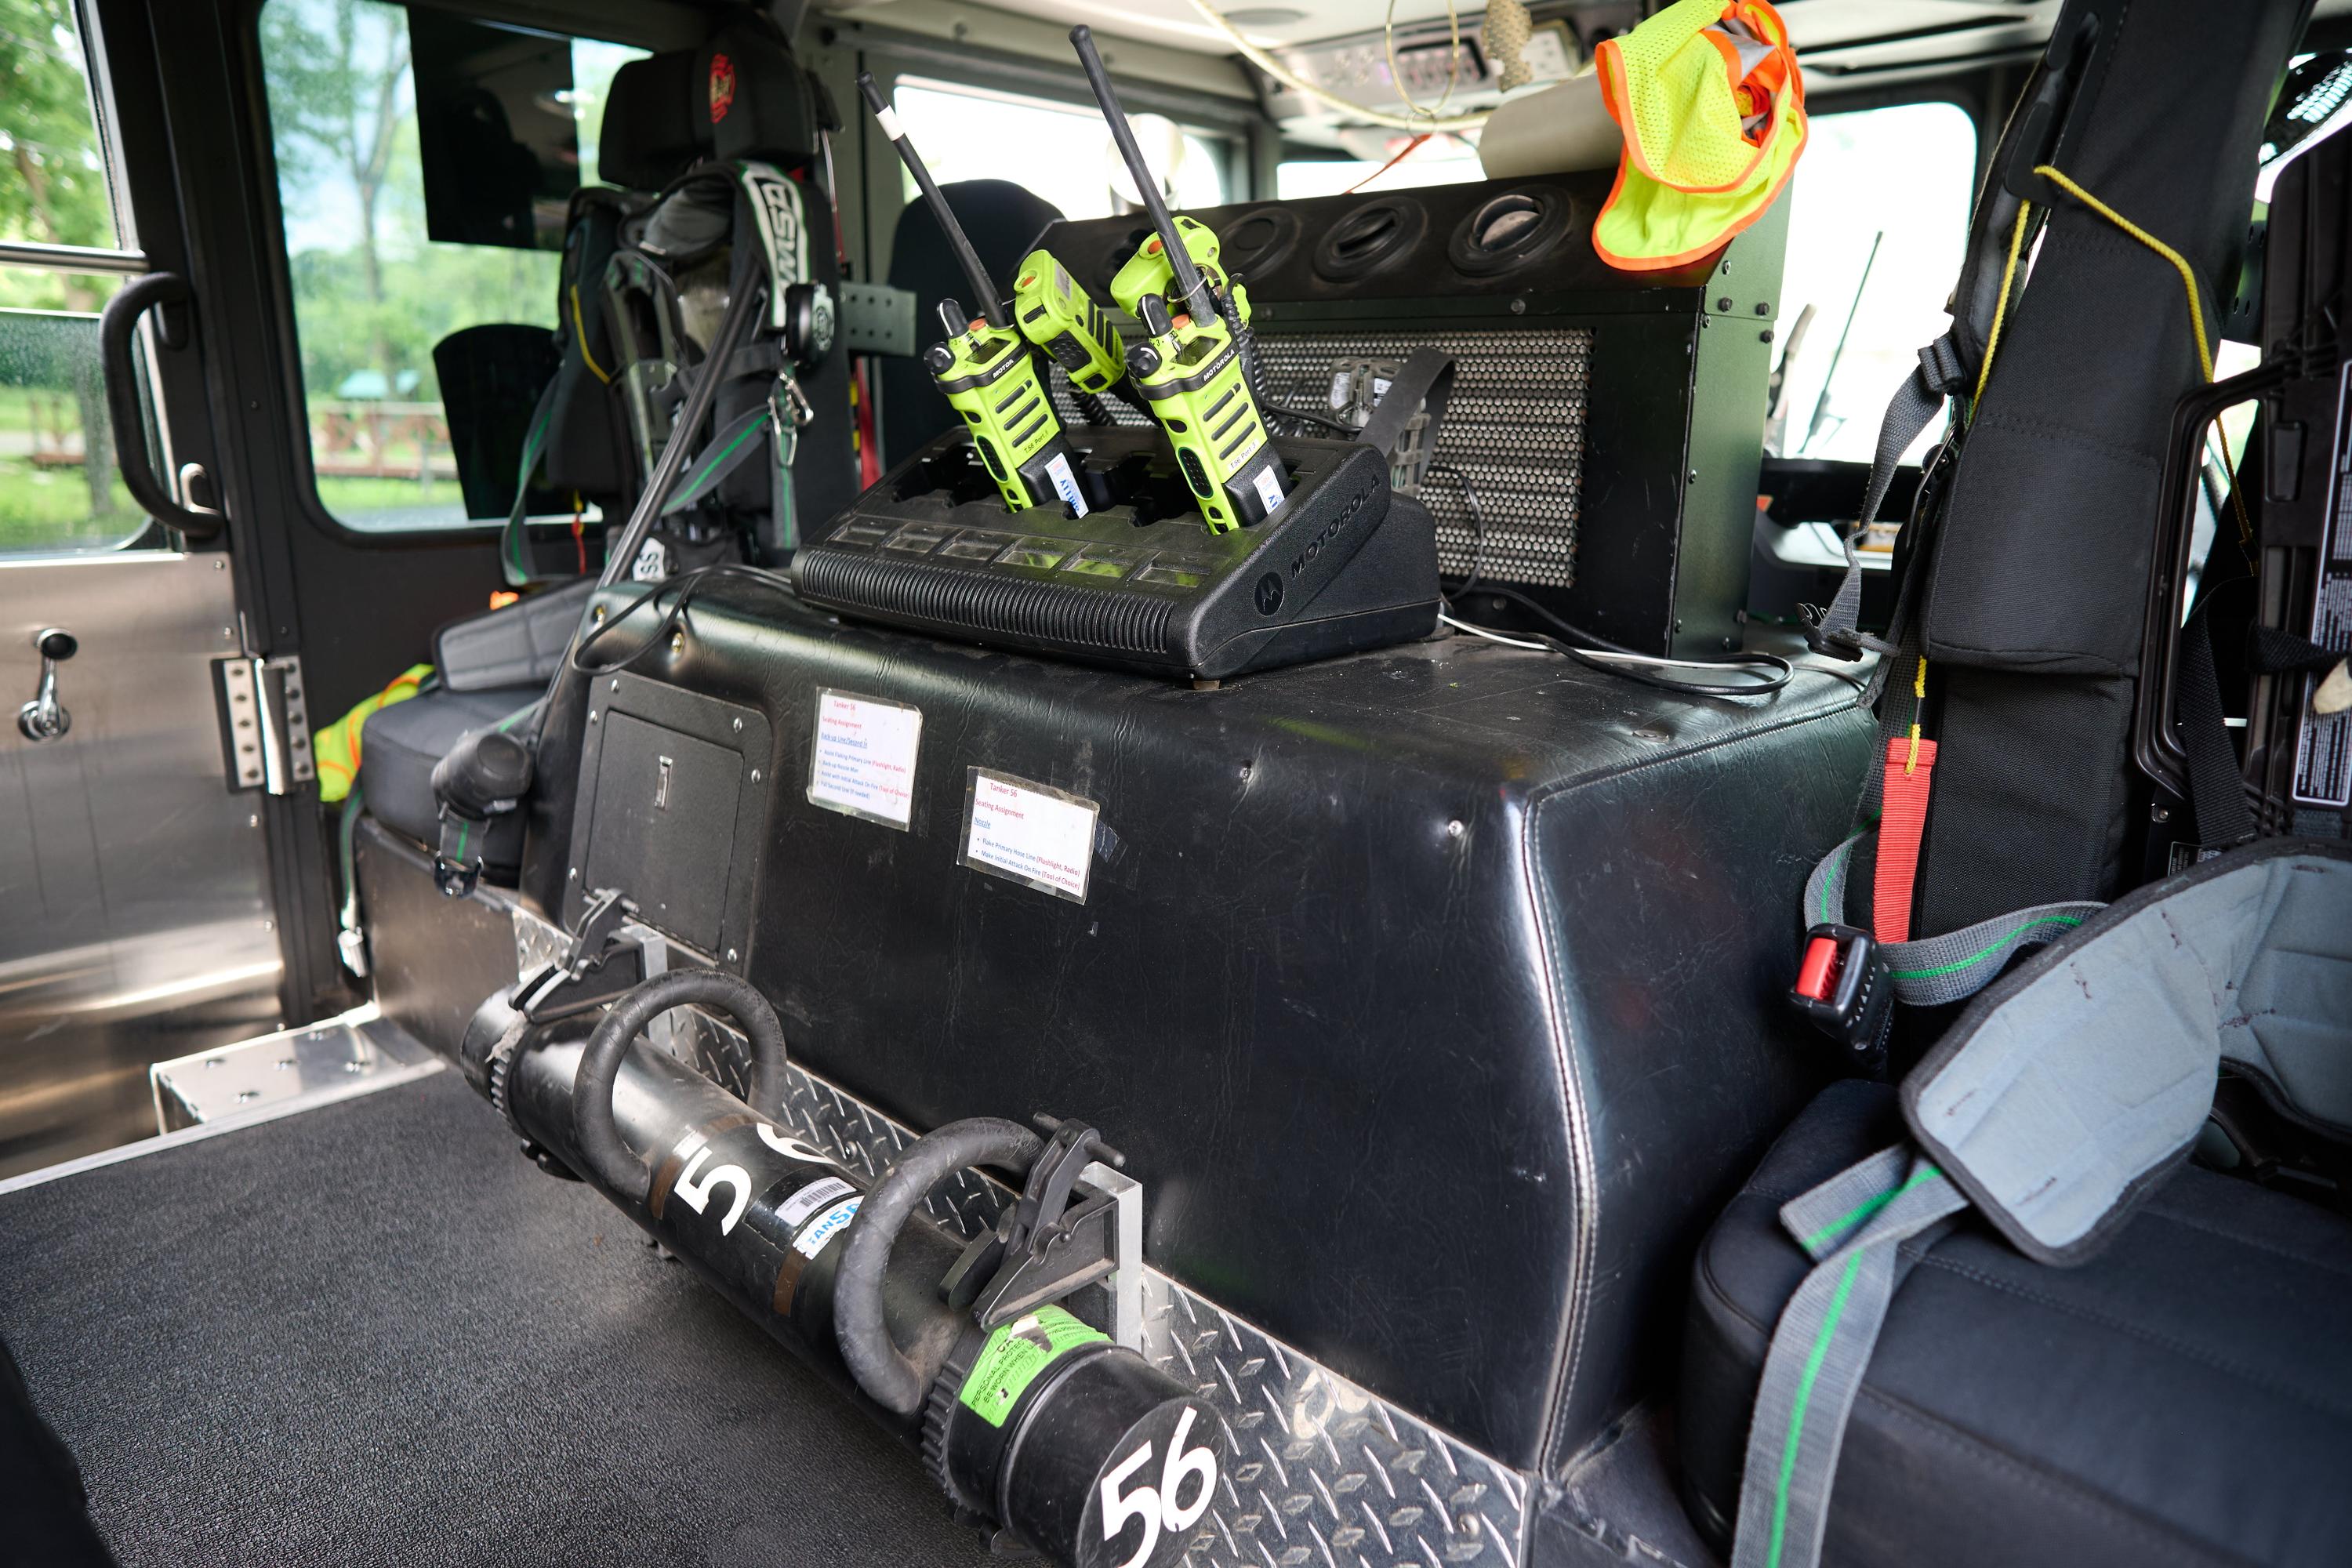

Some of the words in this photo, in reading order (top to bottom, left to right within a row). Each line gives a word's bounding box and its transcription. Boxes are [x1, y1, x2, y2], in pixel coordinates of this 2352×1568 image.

[1203, 348, 1236, 382] MOTOROLA
[1290, 473, 1381, 580] MOTOROLA
[822, 716, 837, 726] Seating
[838, 719, 862, 729] Assignment
[834, 700, 849, 710] Tanker
[990, 782, 1009, 795] Tanker
[1011, 789, 1018, 797] 56
[974, 816, 991, 829] Nozzle
[975, 798, 994, 811] Seating
[995, 804, 1024, 819] Assignment
[981, 850, 994, 860] Make
[994, 855, 1008, 864] Initial
[1008, 859, 1023, 869] Attack
[1032, 867, 1041, 876] Fire
[1041, 870, 1054, 881] (Tool
[1061, 877, 1080, 891] Choice)
[982, 837, 995, 848] Flake
[995, 842, 1013, 855] Primary
[1013, 848, 1025, 858] Hose
[1025, 852, 1036, 862] Line
[1036, 855, 1063, 872] (Flashlight,
[1064, 865, 1080, 877] Radio)
[971, 1366, 1000, 1406] PERSONAL
[983, 1390, 994, 1403] BE
[992, 1370, 1009, 1392] WORN
[1008, 1349, 1028, 1371] WHEN
[1101, 1406, 1217, 1568] 56
